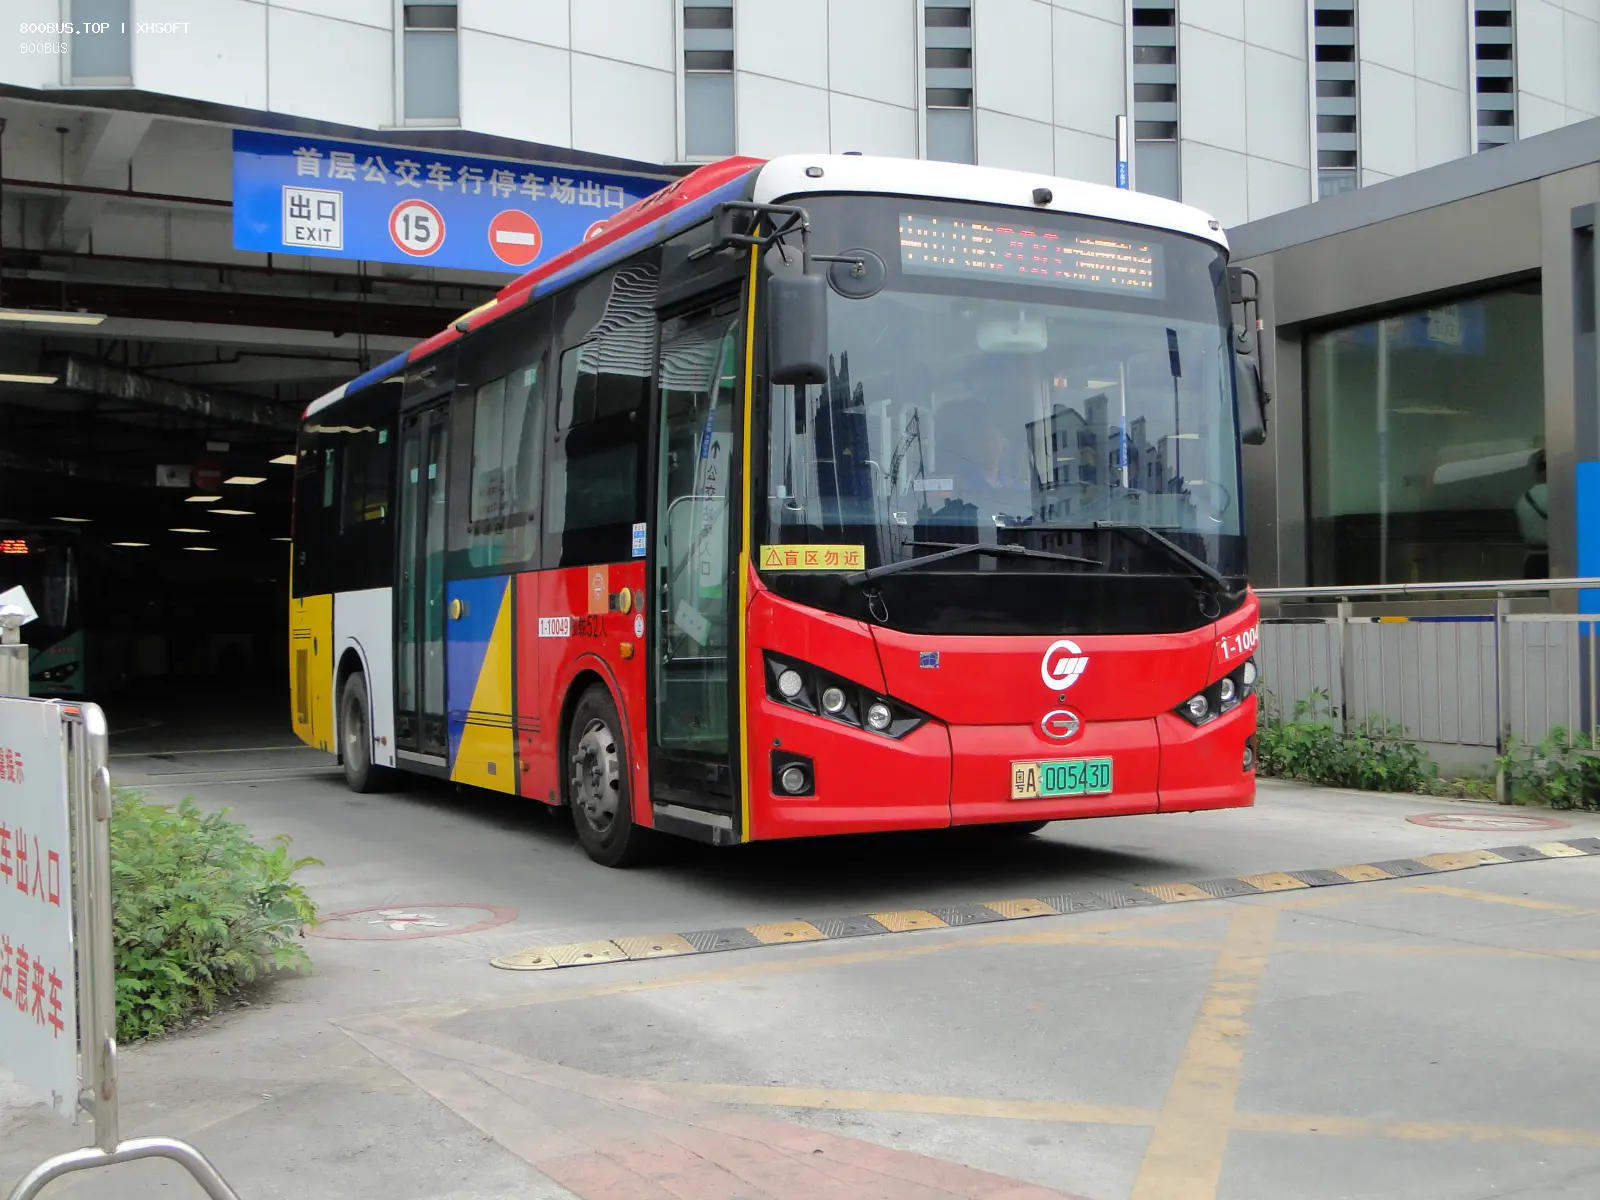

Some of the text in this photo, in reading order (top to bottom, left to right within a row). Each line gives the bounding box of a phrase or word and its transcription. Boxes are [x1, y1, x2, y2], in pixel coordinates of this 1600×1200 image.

[292, 147, 625, 209] 首层公交车行停车场出口
[289, 194, 336, 222] 出口
[295, 226, 332, 243] EXIT
[402, 213, 431, 243] 15
[783, 550, 859, 566] 盲区勿近
[540, 618, 569, 636] 1-10049
[1014, 763, 1110, 793] 粤A 00543D
[0, 820, 61, 908] 车出入口
[0, 934, 65, 1039] 注意来车
